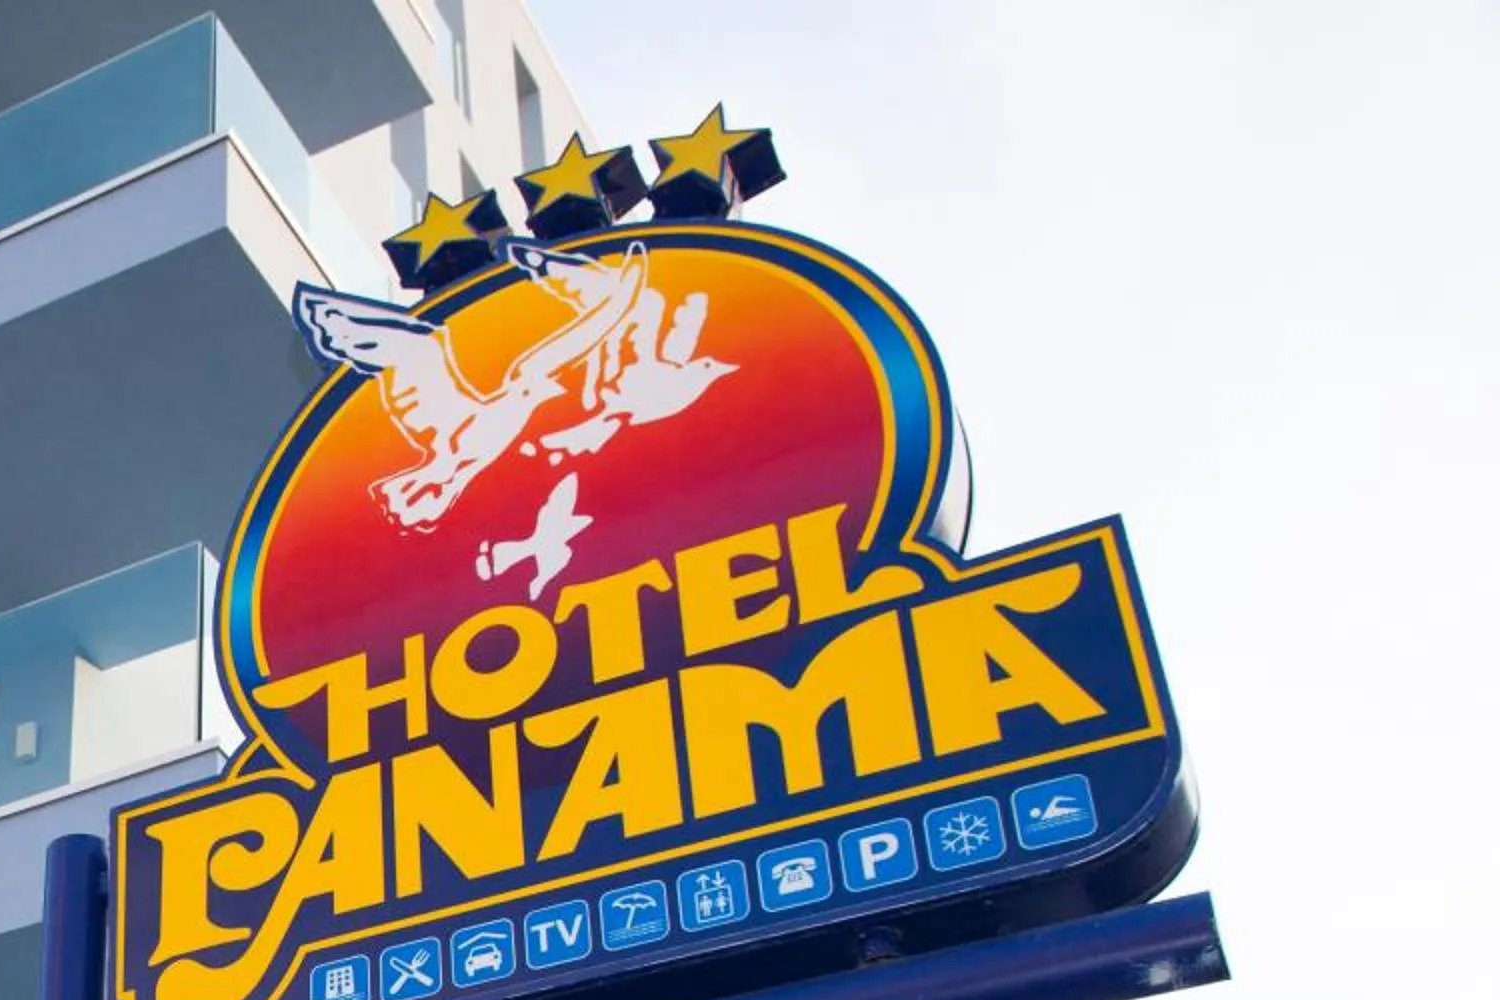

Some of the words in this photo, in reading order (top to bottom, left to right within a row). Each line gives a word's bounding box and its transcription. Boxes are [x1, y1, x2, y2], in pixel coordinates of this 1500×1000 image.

[252, 503, 924, 764] HOTEL
[860, 833, 900, 881] P
[530, 913, 584, 954] TV
